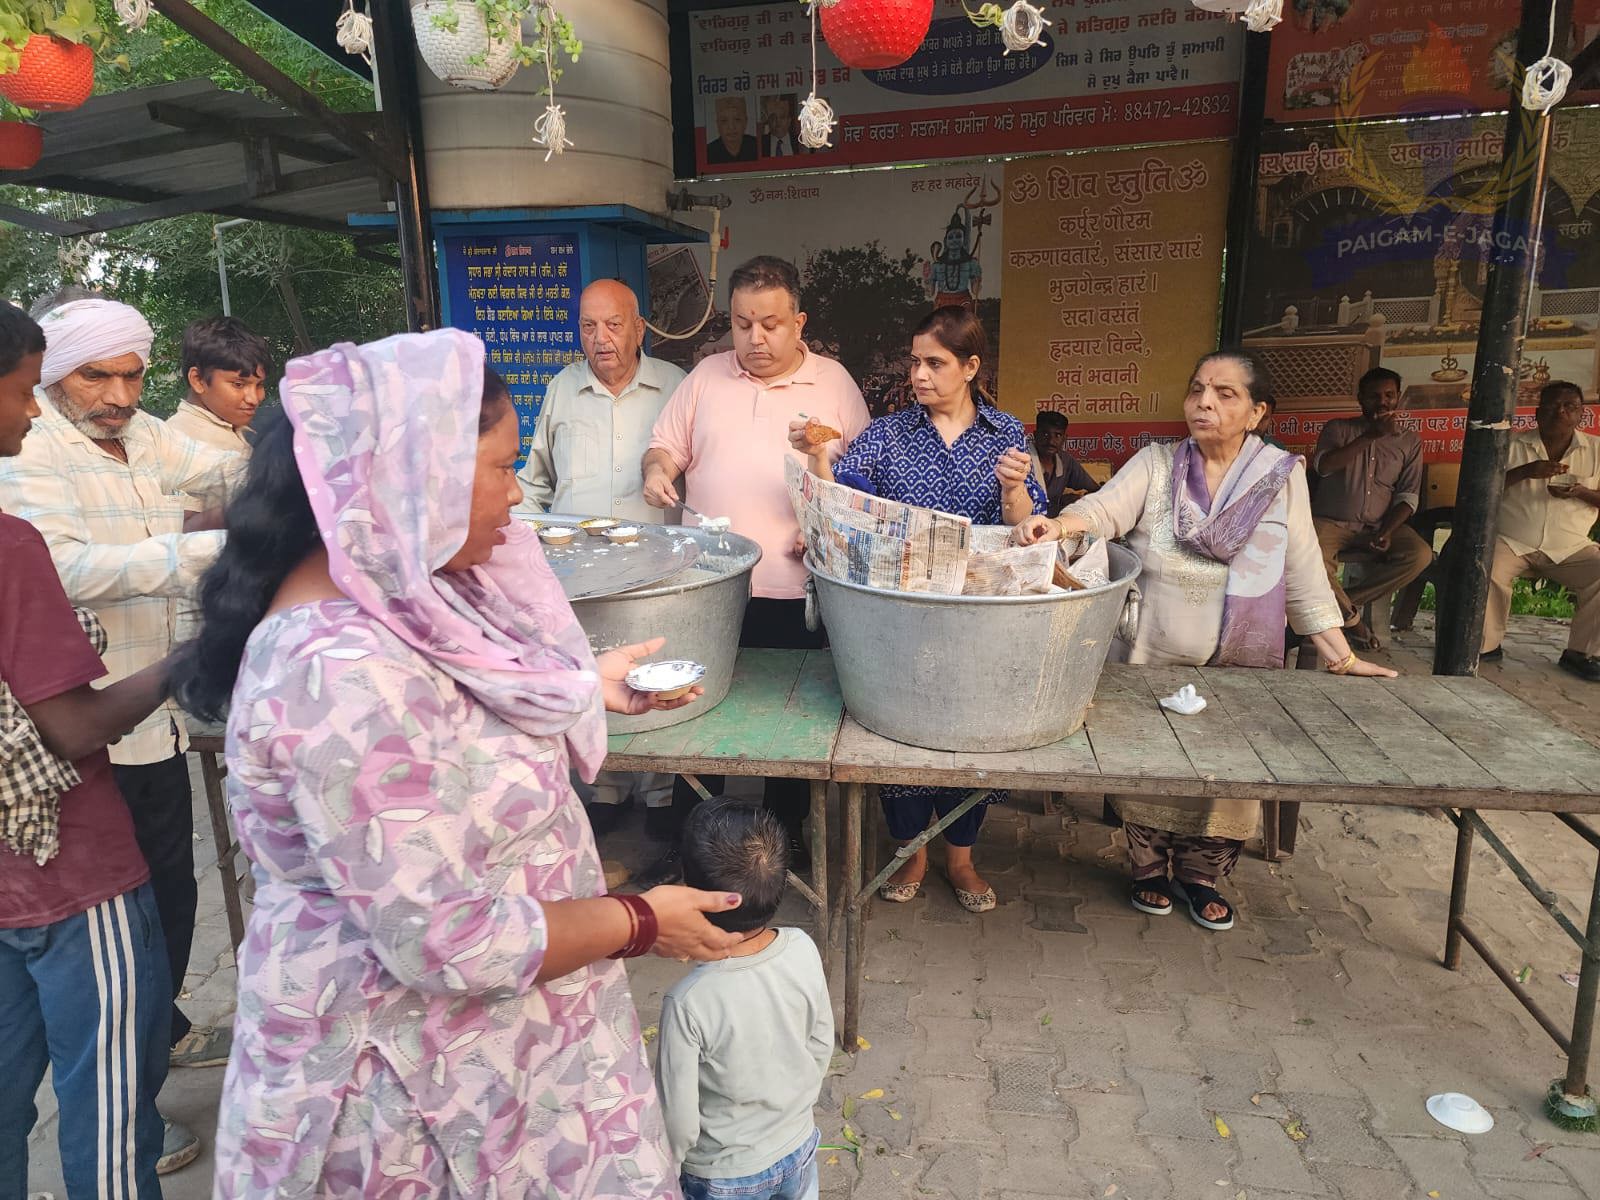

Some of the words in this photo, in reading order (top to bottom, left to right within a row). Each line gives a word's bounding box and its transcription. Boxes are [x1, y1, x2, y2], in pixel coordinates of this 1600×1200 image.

[697, 14, 750, 31] ਵਾਹਿਗੁਰੂ
[755, 9, 771, 24] ਜੀ
[777, 10, 794, 23] ਕਾ
[1056, 18, 1068, 35] ਜੇ
[1136, 7, 1177, 28] ਨਦਰਿ
[699, 36, 752, 55] ਵਾਹਿਗੁਰੂ
[757, 33, 772, 48] ਜੀ
[778, 31, 794, 46] ਕੀ
[966, 30, 972, 47] ਤੇ
[1055, 52, 1078, 67] ਜਿਸ
[1084, 48, 1093, 64] ਕੇ
[1099, 46, 1122, 63] ਸਿਰ
[1127, 42, 1160, 66] ਊਪਰਿ
[1165, 40, 1176, 62] ਤੂੰ
[1181, 36, 1225, 58] ਸੁਆਮੀ
[697, 74, 728, 94] ਕਿਰਤ
[733, 70, 751, 92] ਕਰੋ
[755, 73, 779, 90] ਨਾਮ
[785, 65, 804, 88] ਜਪੋ
[876, 69, 897, 82] ਨਾਨਕ
[931, 60, 939, 77] ਤੇ
[1103, 73, 1120, 90] ਦੁਖੁ
[1126, 68, 1150, 85] ਕੈਸਾ
[844, 120, 864, 142] ਸੇਵਾ
[910, 119, 950, 137] ਸਤਨਾਮ
[954, 111, 990, 136] ਹਸੀਜਾ
[993, 107, 1015, 131] ਅਤੇ
[1019, 111, 1048, 137] ਸਮੂਹ
[1052, 103, 1097, 128] ਪਰਿਵਾਰ
[1123, 94, 1231, 121] 88472-42832
[1320, 147, 1353, 170] राम
[1390, 138, 1450, 164] सबका
[911, 179, 926, 194] हर
[927, 178, 942, 192] हर
[943, 173, 982, 190] महादेव
[1047, 166, 1099, 202] शिव
[1105, 157, 1173, 204] स्तुति
[1059, 207, 1099, 240] कर्पूर
[1103, 207, 1152, 231] गौरम
[1114, 239, 1163, 263] संसार
[1168, 235, 1203, 260] सारं
[530, 261, 537, 278] ਜੀ
[529, 283, 535, 299] ਜੀ
[537, 283, 544, 299] ਦੀ
[1048, 272, 1113, 303] भुजगेन्द्र
[1062, 308, 1094, 326] सदा
[1099, 301, 1141, 325] वसंतं
[1048, 336, 1102, 361] हृदयार
[1106, 331, 1152, 357] विन्दे,
[1057, 364, 1082, 386] भवं
[1086, 363, 1139, 386] भवानी
[1086, 391, 1141, 414] नमामि
[1279, 416, 1300, 435] भी
[1426, 416, 1449, 432] पर
